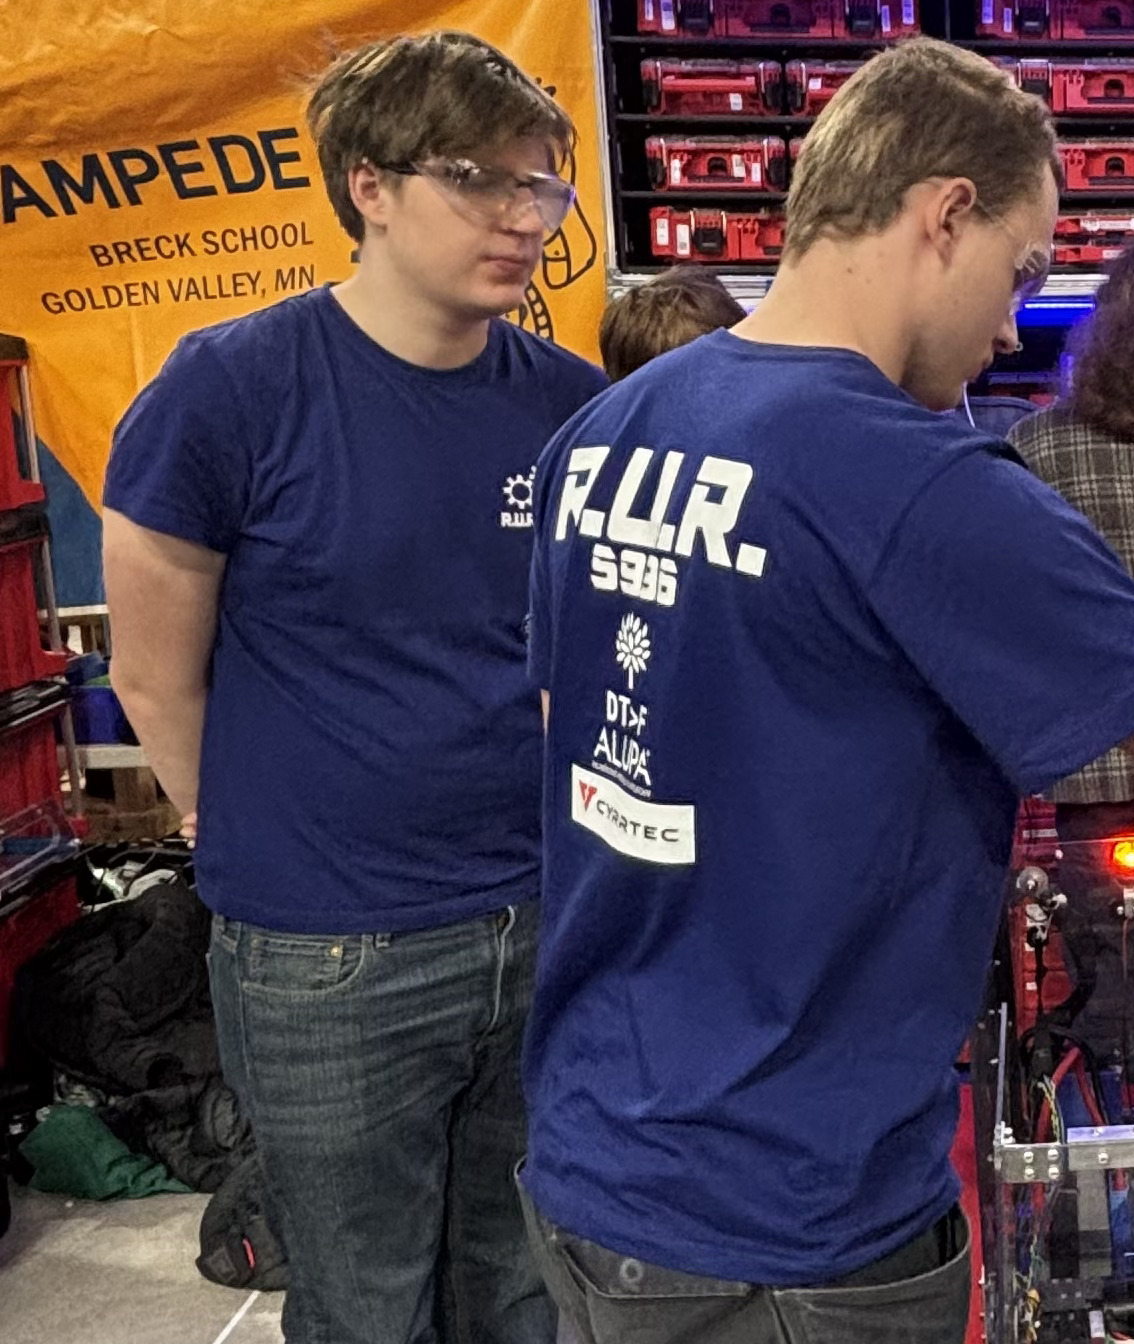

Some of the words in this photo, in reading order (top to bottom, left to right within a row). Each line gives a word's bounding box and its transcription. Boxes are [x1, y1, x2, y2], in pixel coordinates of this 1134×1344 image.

[0, 127, 310, 224] AMPEDE
[89, 232, 196, 268] BRECK
[201, 221, 314, 255] SCHOOL
[41, 280, 160, 316] GOLDEN
[166, 270, 266, 303] VALLEY,
[274, 264, 315, 292] MN
